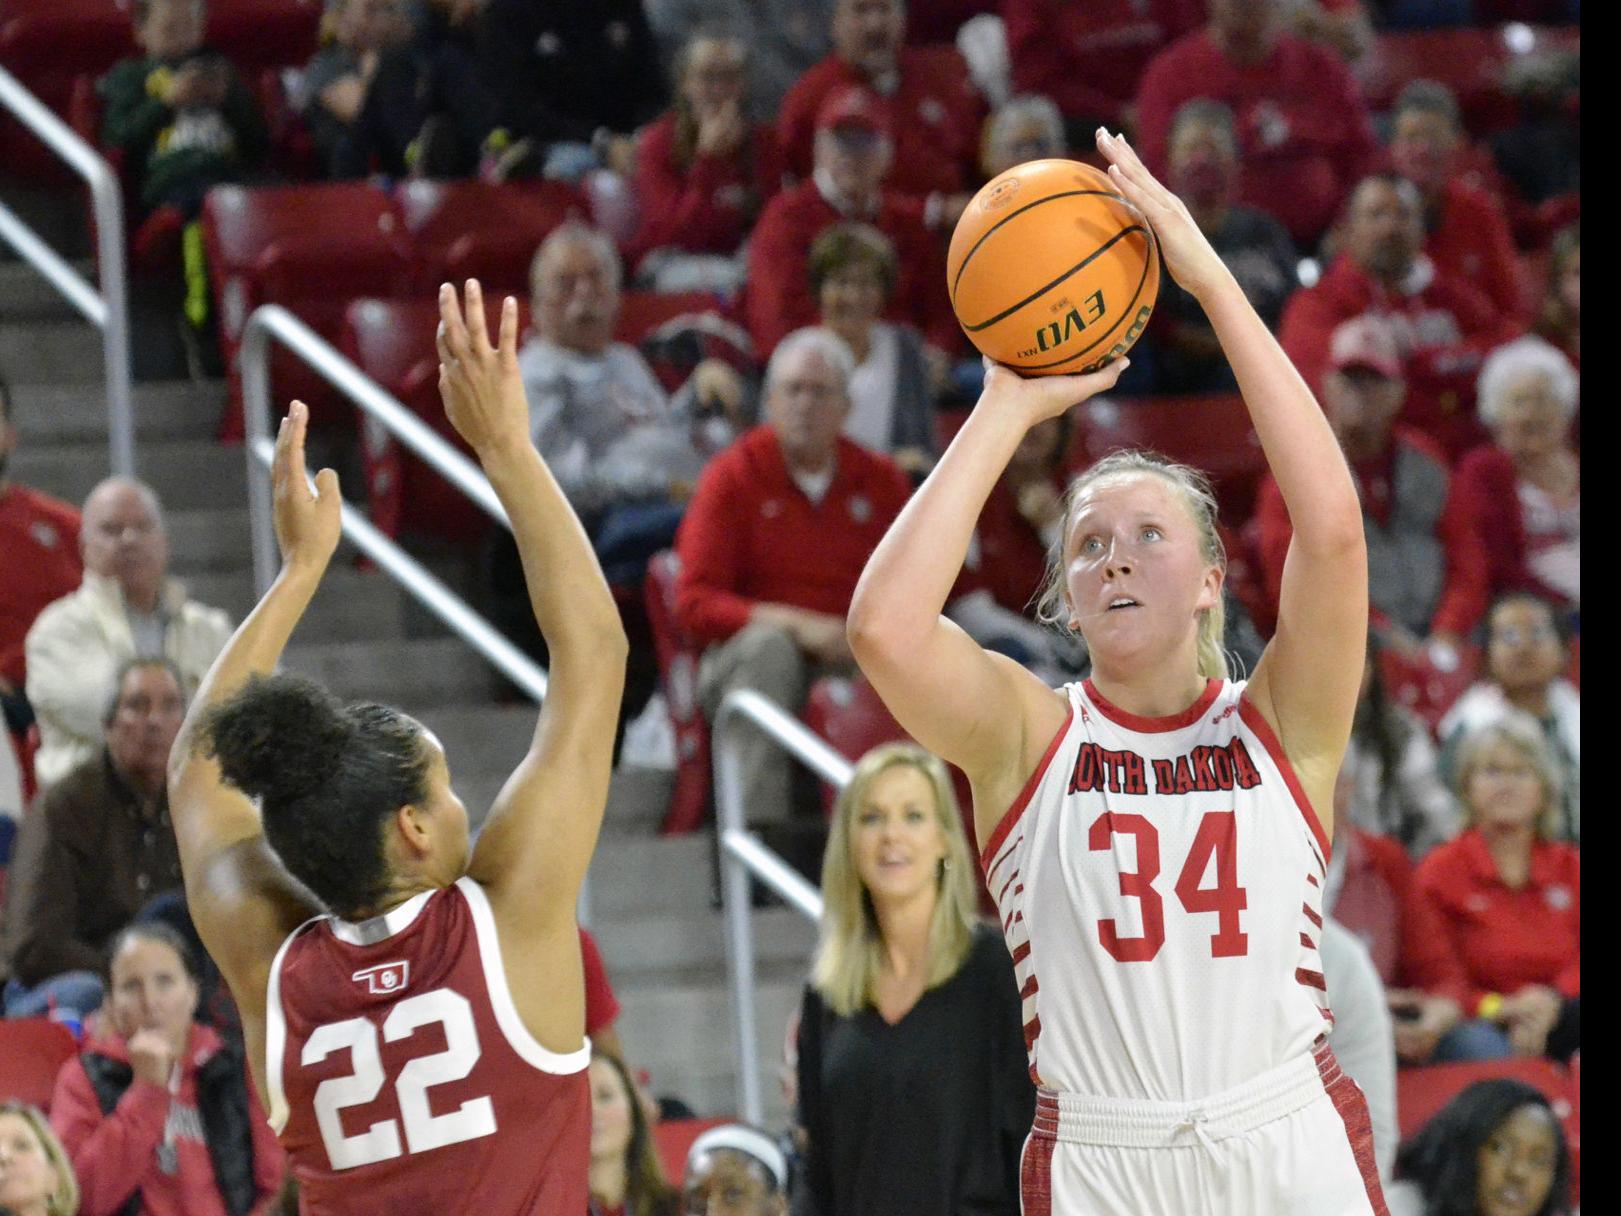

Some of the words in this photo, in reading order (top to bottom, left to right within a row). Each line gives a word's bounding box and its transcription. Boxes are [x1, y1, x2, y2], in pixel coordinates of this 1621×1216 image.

[1037, 289, 1106, 352] EVO
[1088, 811, 1248, 962] 34
[301, 987, 498, 1171] 22
